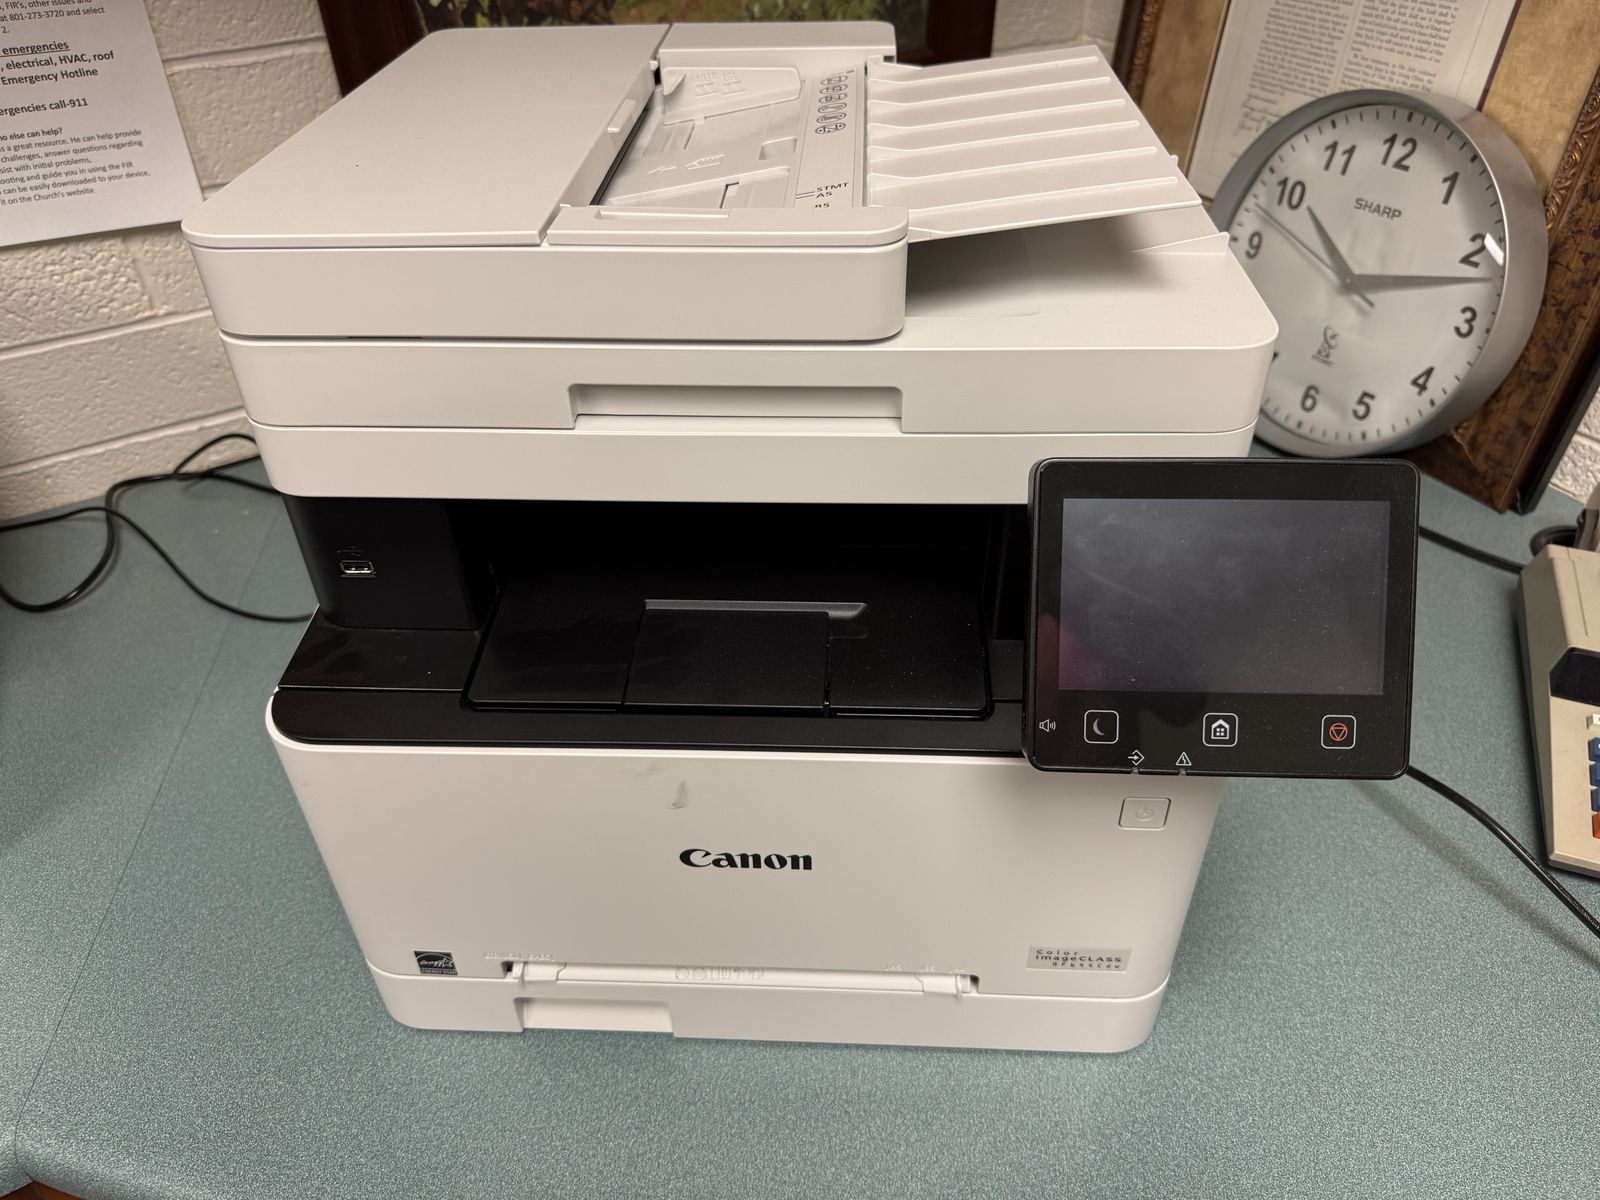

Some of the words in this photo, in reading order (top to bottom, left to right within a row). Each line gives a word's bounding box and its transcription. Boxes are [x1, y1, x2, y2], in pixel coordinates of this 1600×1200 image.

[28, 0, 50, 8] other
[9, 10, 65, 21] 801-273-3720
[83, 7, 105, 15] select
[3, 41, 69, 55] emergencies
[6, 57, 57, 70] electrical,
[59, 53, 91, 65] HVAC,
[93, 50, 114, 61] roof
[1, 72, 58, 85] Emergency
[61, 68, 98, 79] Hotline
[49, 97, 88, 110] call-911
[9, 132, 25, 140] else
[41, 127, 63, 136] help?
[13, 142, 33, 152] great
[96, 132, 114, 140] help
[114, 129, 142, 139] provide
[1, 153, 43, 163] challenges,
[44, 149, 70, 158] answer
[72, 144, 107, 154] questions
[1323, 140, 1357, 176] 11
[1381, 132, 1418, 173] 12
[14, 163, 32, 172] with
[33, 160, 53, 170] initial
[26, 174, 41, 182] and
[42, 170, 62, 180] guide
[64, 169, 78, 178] you
[79, 167, 87, 175] in
[87, 165, 107, 174] using
[108, 163, 120, 171] the
[17, 185, 28, 193] be
[29, 183, 50, 192] easily
[51, 176, 97, 189] downloaded
[107, 174, 123, 182] your
[817, 182, 848, 192] STMT
[1276, 175, 1306, 211] 10
[1440, 171, 1460, 205] 1
[19, 195, 32, 203] the
[816, 191, 832, 199] A5
[1353, 197, 1402, 221] SHARP
[1245, 231, 1262, 260] 9
[1458, 232, 1487, 269] 2
[1453, 306, 1478, 339] 3
[1411, 365, 1435, 397] 4
[1300, 384, 1321, 412] 6
[1351, 391, 1376, 421] 5
[679, 848, 813, 871] Canon
